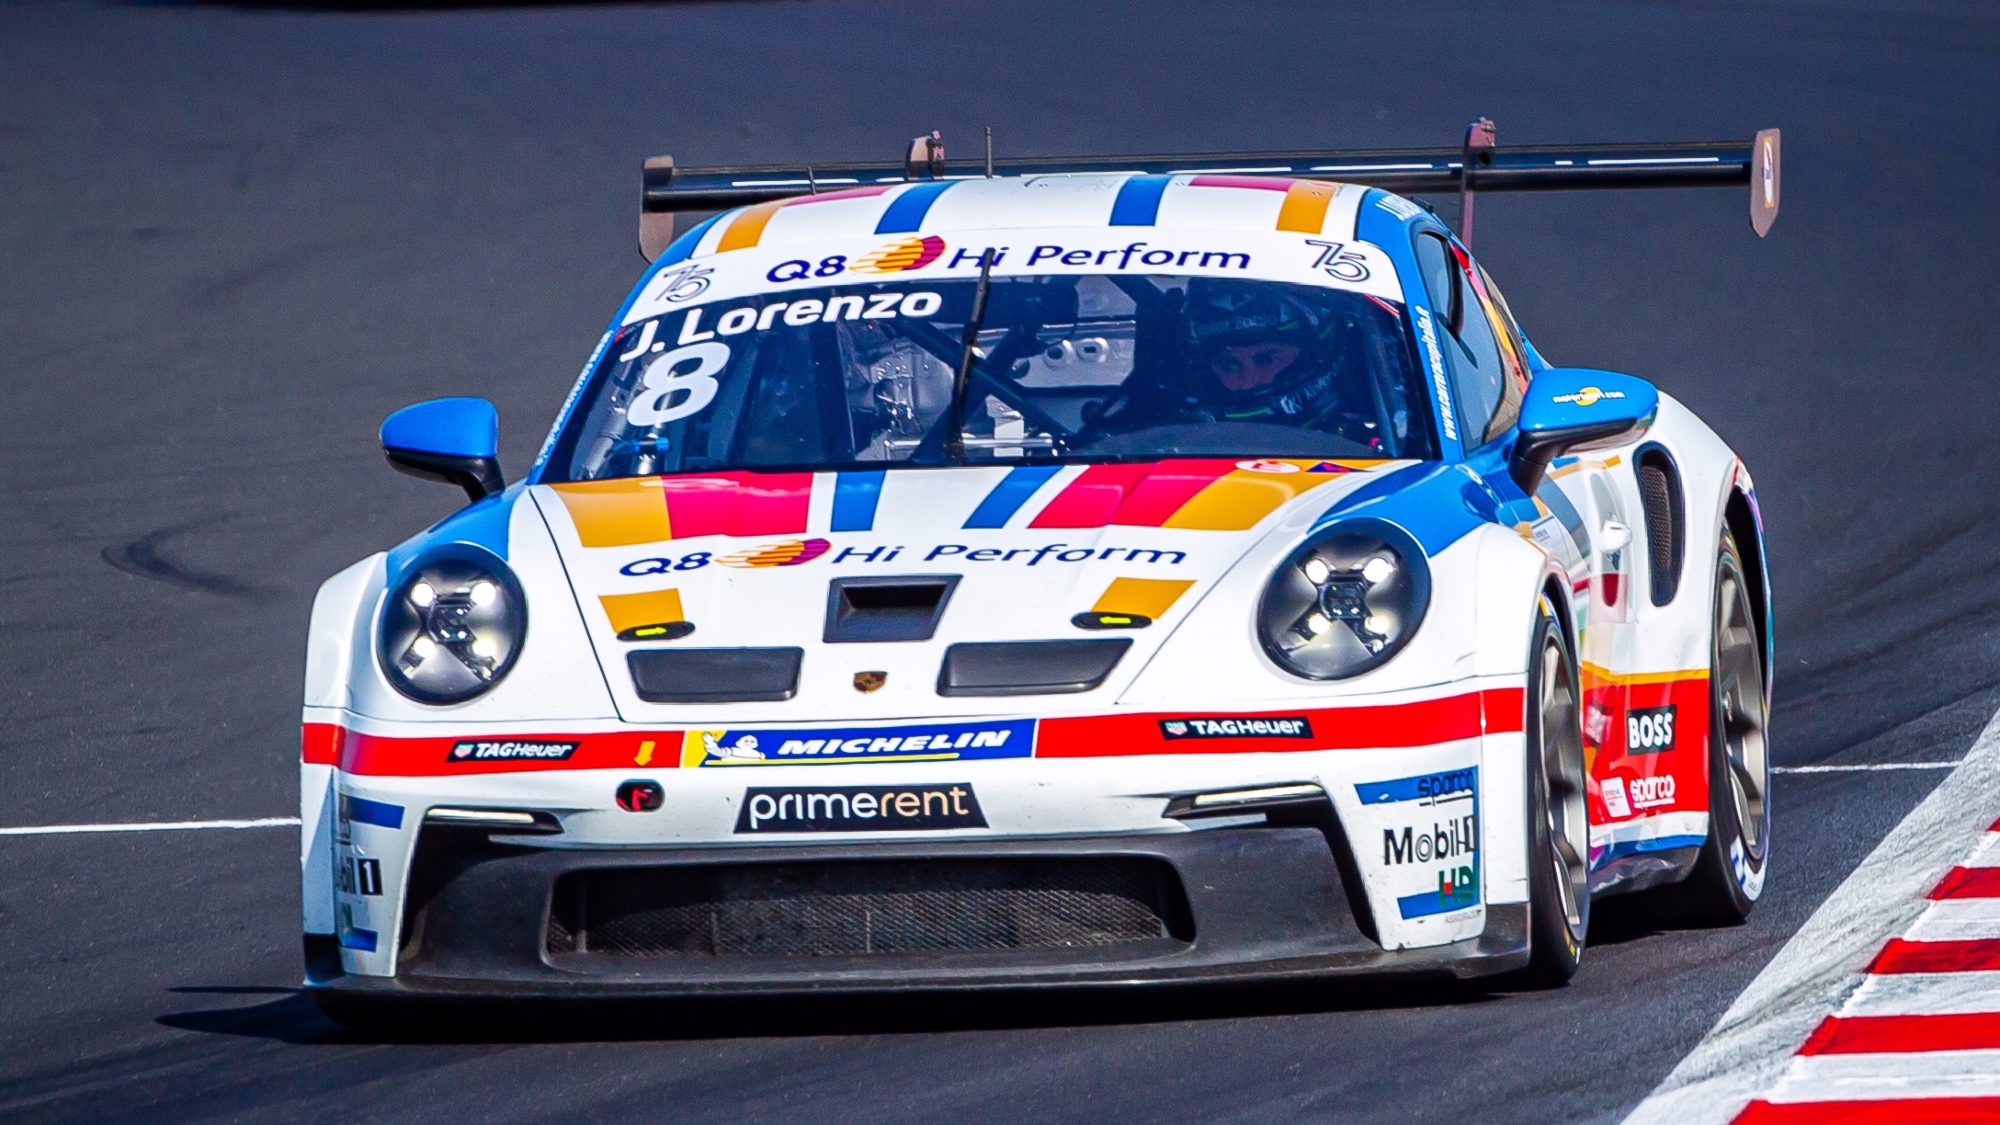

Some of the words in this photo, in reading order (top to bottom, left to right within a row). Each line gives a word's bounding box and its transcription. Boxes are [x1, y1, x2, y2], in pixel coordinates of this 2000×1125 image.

[766, 255, 847, 283] Q8
[948, 247, 1009, 269] Hi
[1026, 242, 1251, 270] Perform
[1305, 239, 1370, 283] 75
[654, 263, 716, 303] 75
[619, 319, 666, 363] J.
[677, 292, 942, 346] Lorenzo
[627, 341, 731, 426] 8
[618, 551, 712, 577] Q8
[832, 545, 907, 565] Hi
[922, 543, 1187, 566] Perform
[777, 730, 1012, 755] MICHELIN
[1628, 712, 1673, 749] BOSS
[749, 786, 969, 829] primerent
[1417, 769, 1474, 807] sparco
[1629, 774, 1676, 810] sparco
